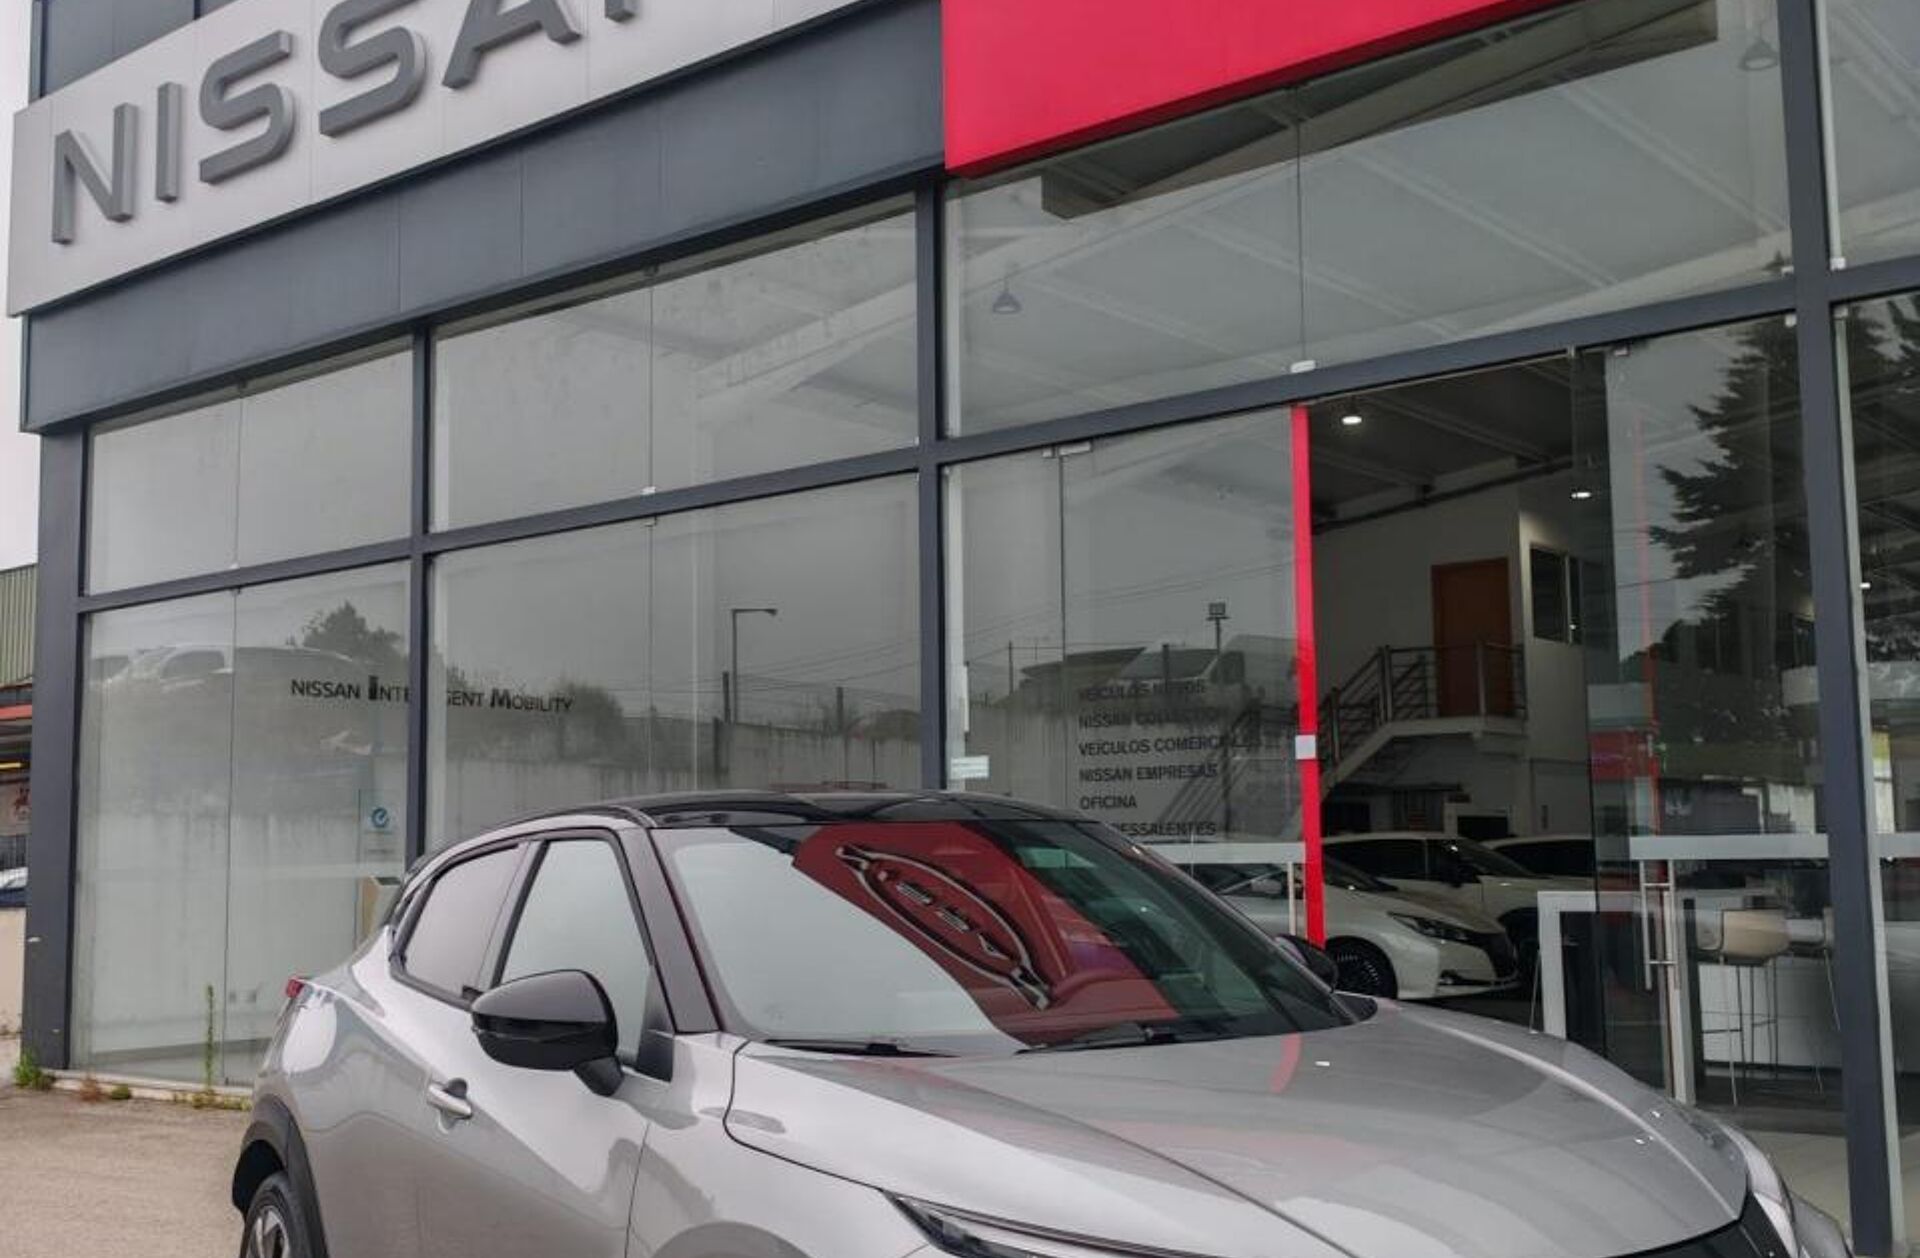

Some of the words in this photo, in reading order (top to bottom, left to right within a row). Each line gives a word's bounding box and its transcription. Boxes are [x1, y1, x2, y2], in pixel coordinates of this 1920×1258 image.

[51, 0, 635, 244] NISSA
[291, 679, 360, 700] NISSAN
[368, 675, 484, 707] INTEENT
[490, 688, 573, 712] MOBILITY
[1079, 766, 1132, 782] NISSAN
[1137, 763, 1218, 781] EMPRESAS
[1079, 794, 1137, 810] OFICINA
